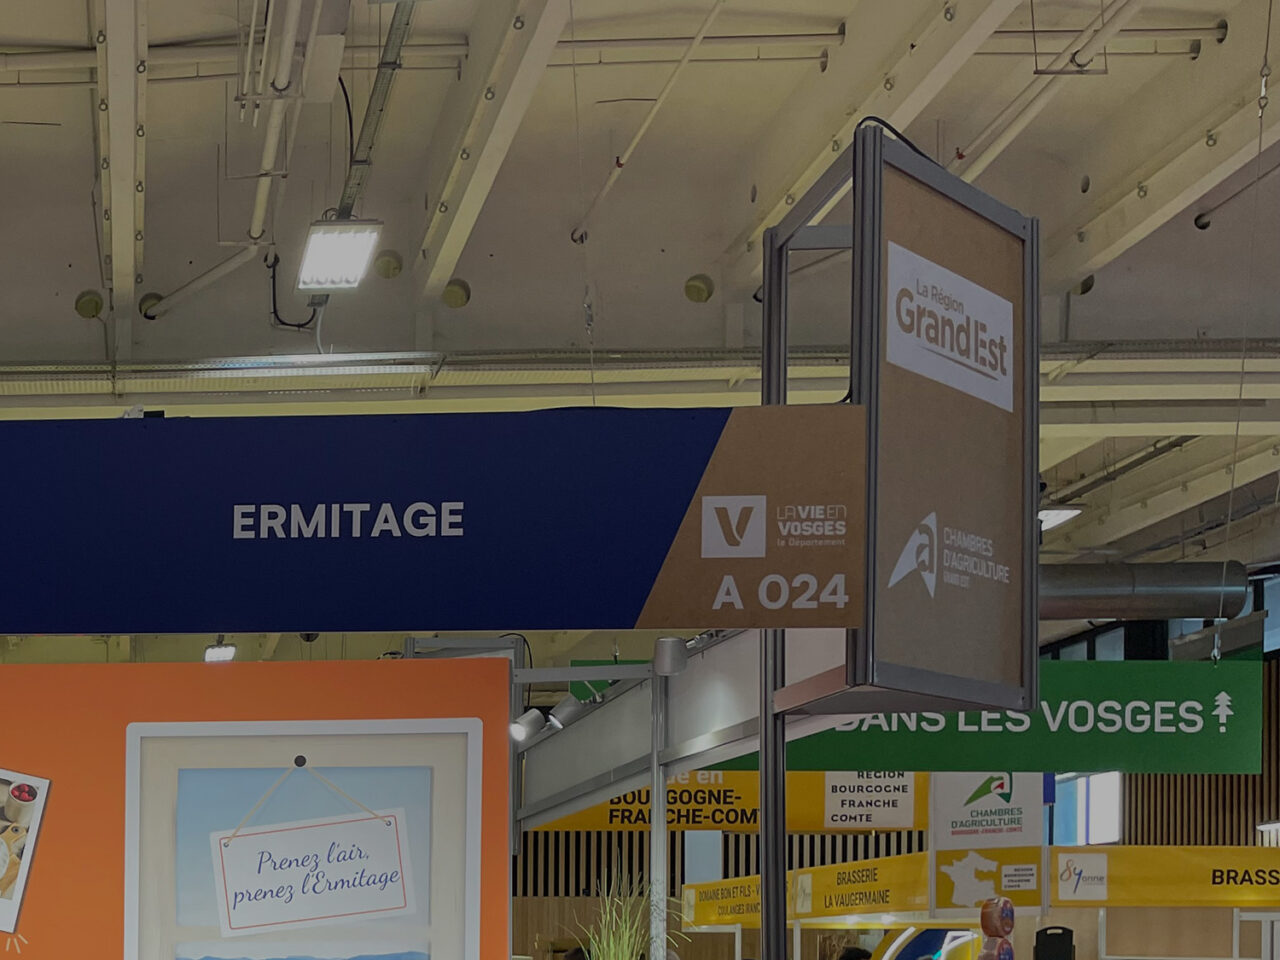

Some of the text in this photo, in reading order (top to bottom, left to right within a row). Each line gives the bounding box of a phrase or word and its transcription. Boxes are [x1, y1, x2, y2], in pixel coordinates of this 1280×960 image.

[916, 278, 964, 315] La Région
[232, 501, 465, 540] ERMITAGE
[797, 505, 825, 519] VIE
[777, 520, 847, 536] VOSGES
[943, 526, 993, 557] CHAMBRES
[943, 548, 1010, 584] D'AGRICULTURE
[711, 573, 849, 610] A 024
[957, 710, 1031, 732] LES
[1040, 699, 1205, 733] VOSGES
[609, 788, 742, 805] BOUGOGNE-
[831, 784, 908, 794] BOURGOGNE
[840, 799, 899, 809] FRANCHE
[970, 806, 1023, 818] CHAMBRES
[609, 808, 760, 825] FRACHE-COM
[830, 813, 873, 823] COMTE
[951, 817, 1023, 829] D'AGRICULTURE
[257, 850, 321, 875] Prenez
[836, 867, 879, 886] BRASSERIE
[1211, 869, 1280, 885] BRASS
[232, 868, 401, 911] prenez l'Ermitage
[732, 886, 739, 899] ET
[740, 884, 751, 898] FILS
[824, 893, 835, 910] LA
